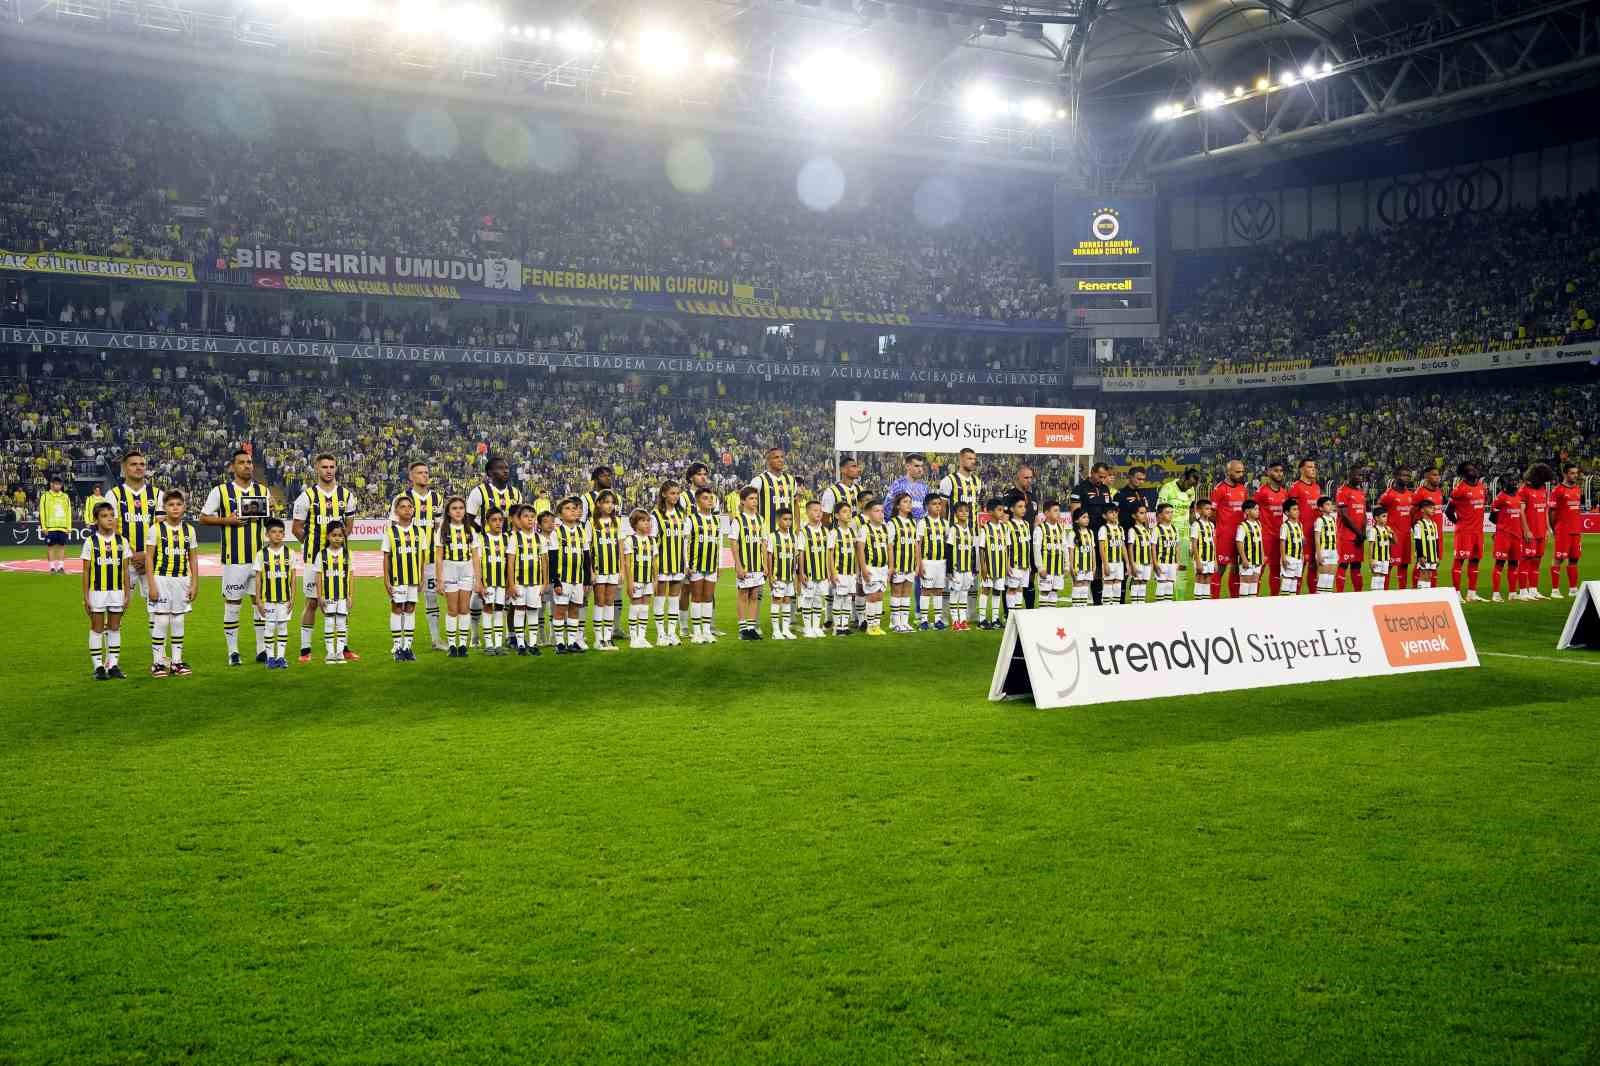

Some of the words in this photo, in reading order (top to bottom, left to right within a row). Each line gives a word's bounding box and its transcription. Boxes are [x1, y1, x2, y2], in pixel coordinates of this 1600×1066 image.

[236, 245, 283, 270] BİR
[290, 250, 386, 275] ŞEHRİN
[395, 256, 484, 281] UMUDU
[665, 276, 729, 296] GURURU
[1078, 279, 1132, 291] Fenercell
[877, 416, 960, 441] trendyol
[963, 423, 1028, 444] SüperLig
[1040, 419, 1081, 432] trendyol
[1045, 433, 1075, 444] yemek
[1384, 610, 1451, 634] trendyol
[1089, 627, 1243, 676] trendyol
[1247, 628, 1362, 669] SüperLig
[1400, 635, 1450, 659] yemek
